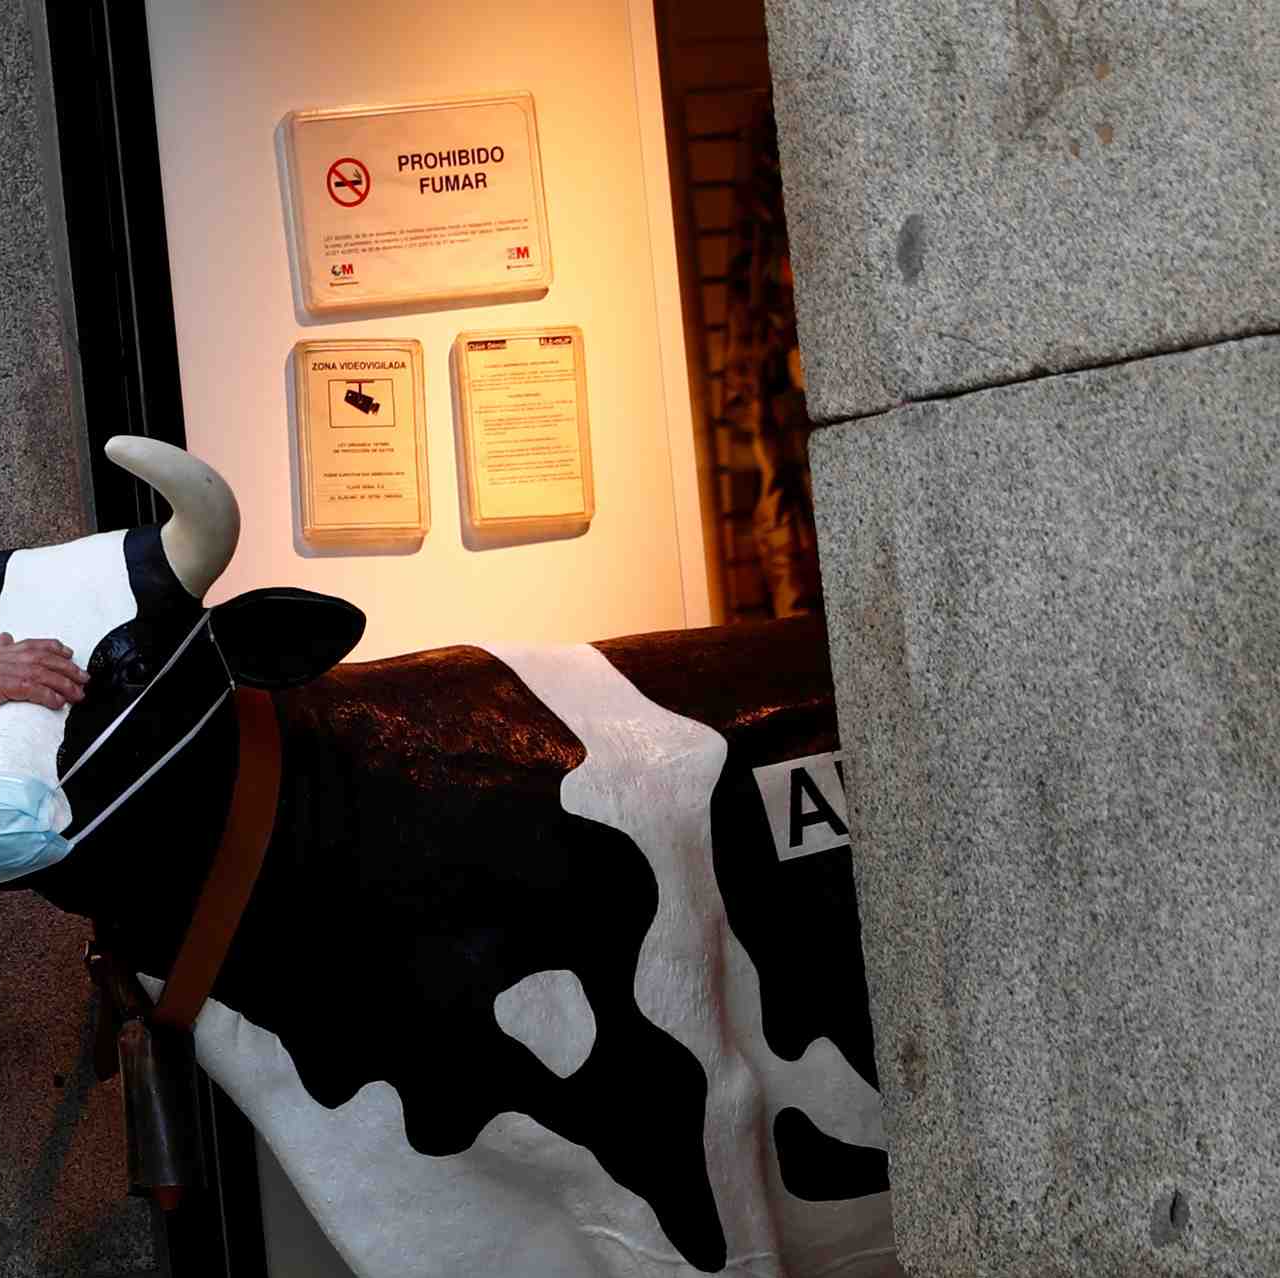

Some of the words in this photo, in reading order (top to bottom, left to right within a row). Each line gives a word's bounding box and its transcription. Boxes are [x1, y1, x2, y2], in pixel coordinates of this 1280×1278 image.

[397, 145, 505, 172] PROHIBIDO
[419, 172, 487, 194] FUMAR
[312, 362, 338, 371] ZONA
[340, 360, 407, 370] VIDEOVIGILADA
